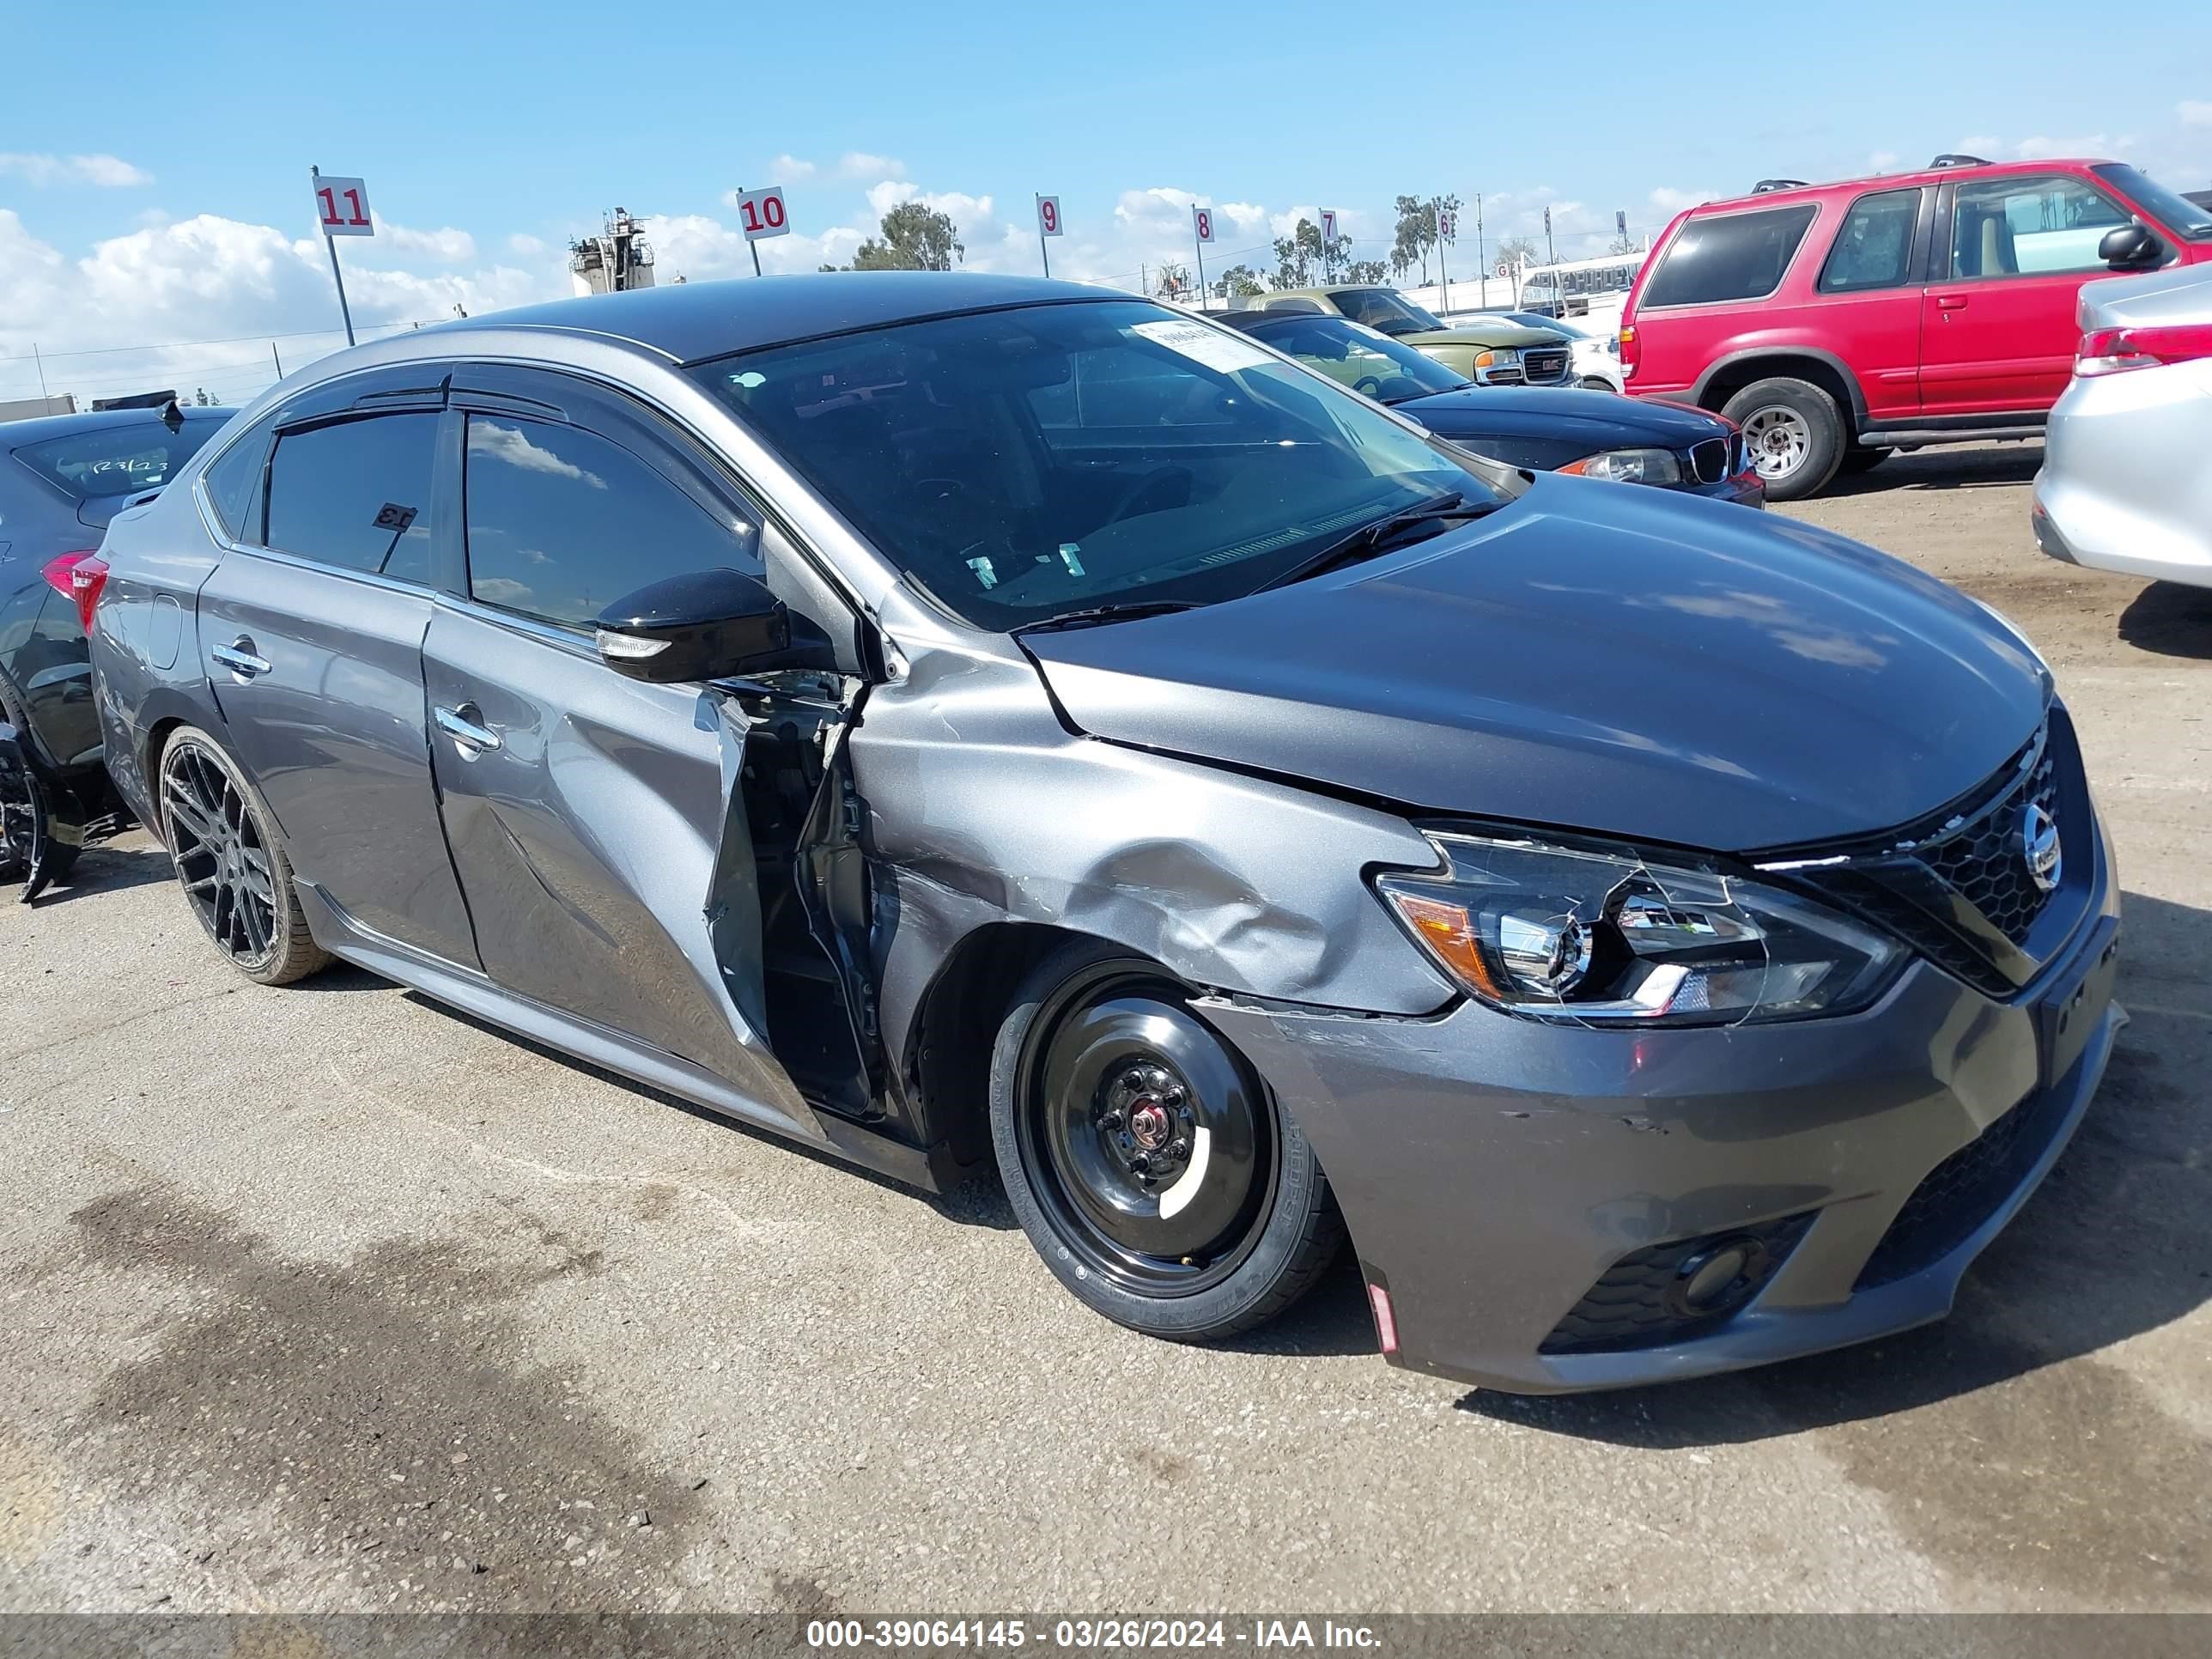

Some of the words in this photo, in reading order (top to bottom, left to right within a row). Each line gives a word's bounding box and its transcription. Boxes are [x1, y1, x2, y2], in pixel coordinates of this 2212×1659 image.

[318, 187, 369, 226] 11
[741, 197, 784, 231] 10
[1042, 201, 1056, 232] 9
[1198, 212, 1210, 239] 8
[1323, 214, 1333, 237] 7
[1441, 214, 1449, 234] 6
[1619, 213, 1625, 232] 4
[1498, 265, 1507, 276] G
